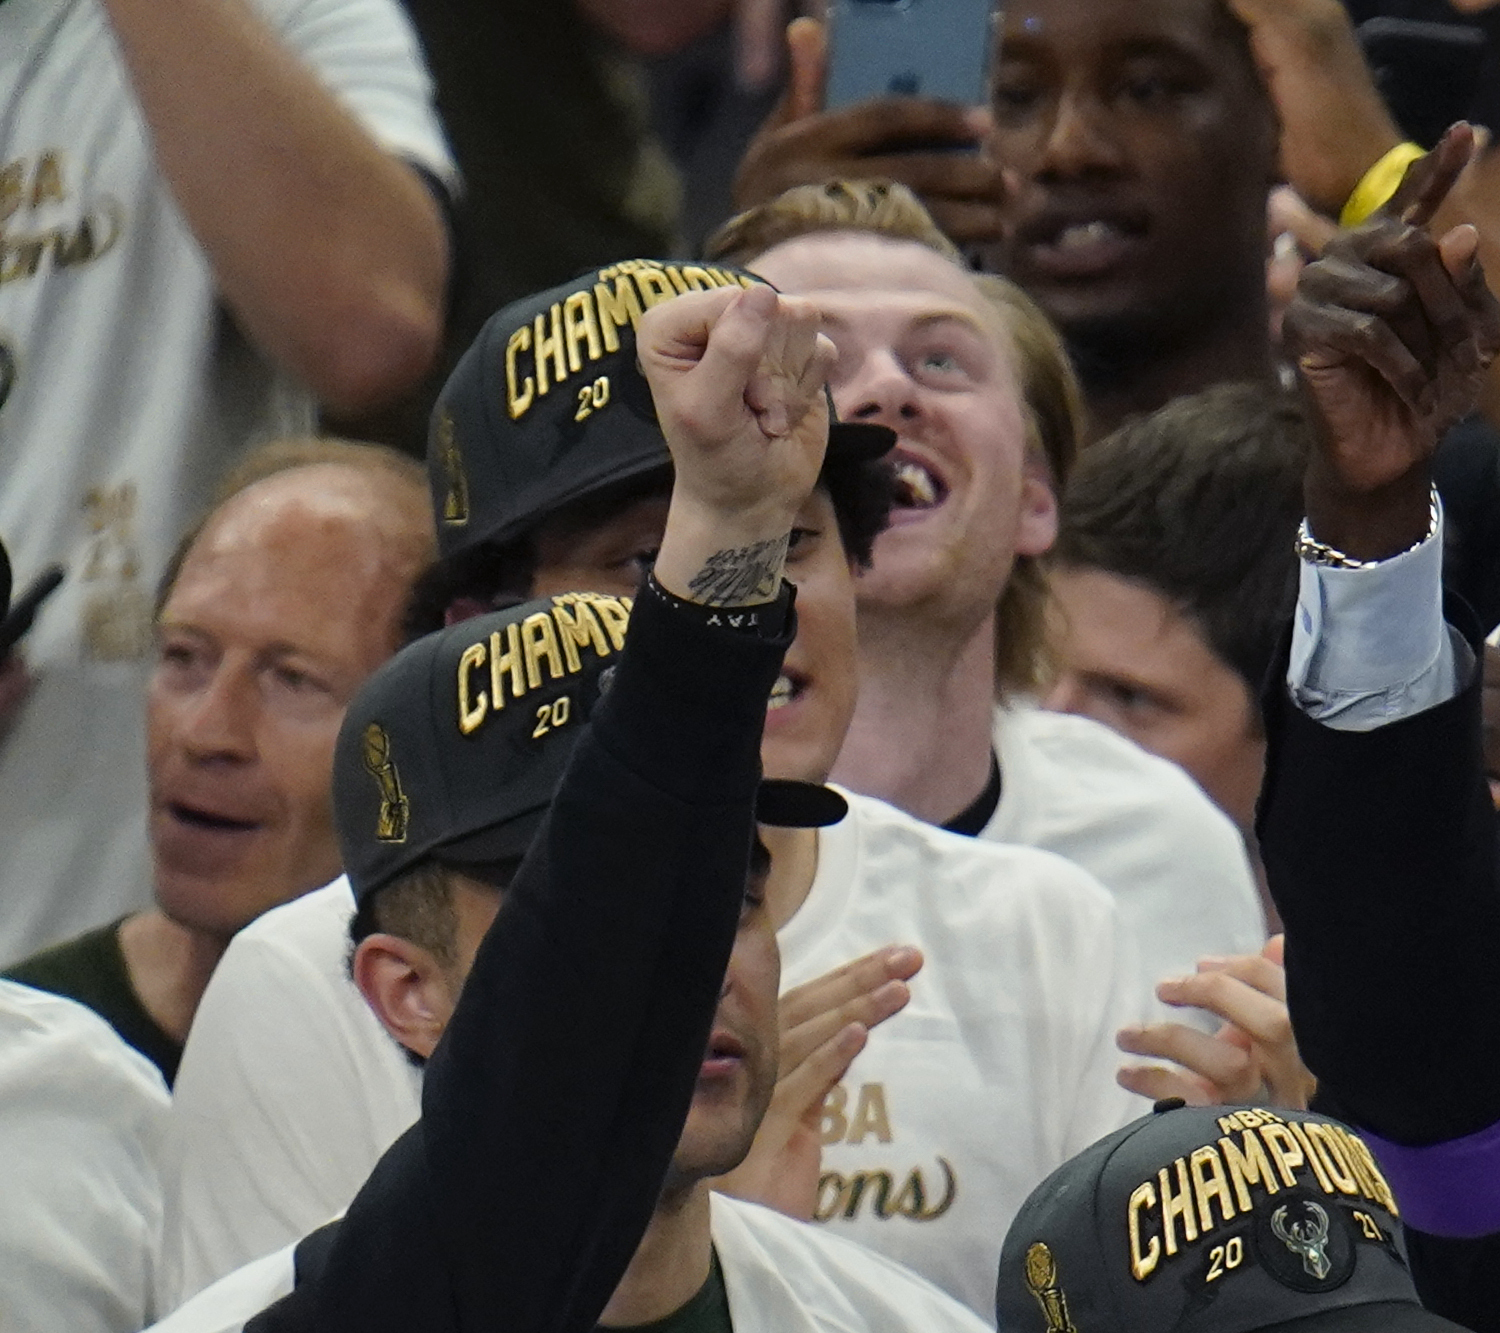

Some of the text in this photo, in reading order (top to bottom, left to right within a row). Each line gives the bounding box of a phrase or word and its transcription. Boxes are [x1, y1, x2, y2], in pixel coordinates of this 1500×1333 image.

[574, 376, 610, 421] 20
[532, 697, 569, 740] 20
[1218, 1108, 1286, 1135] NBA
[1128, 1121, 1399, 1281] CHAMPIONS
[1206, 1210, 1383, 1283] 20 21
